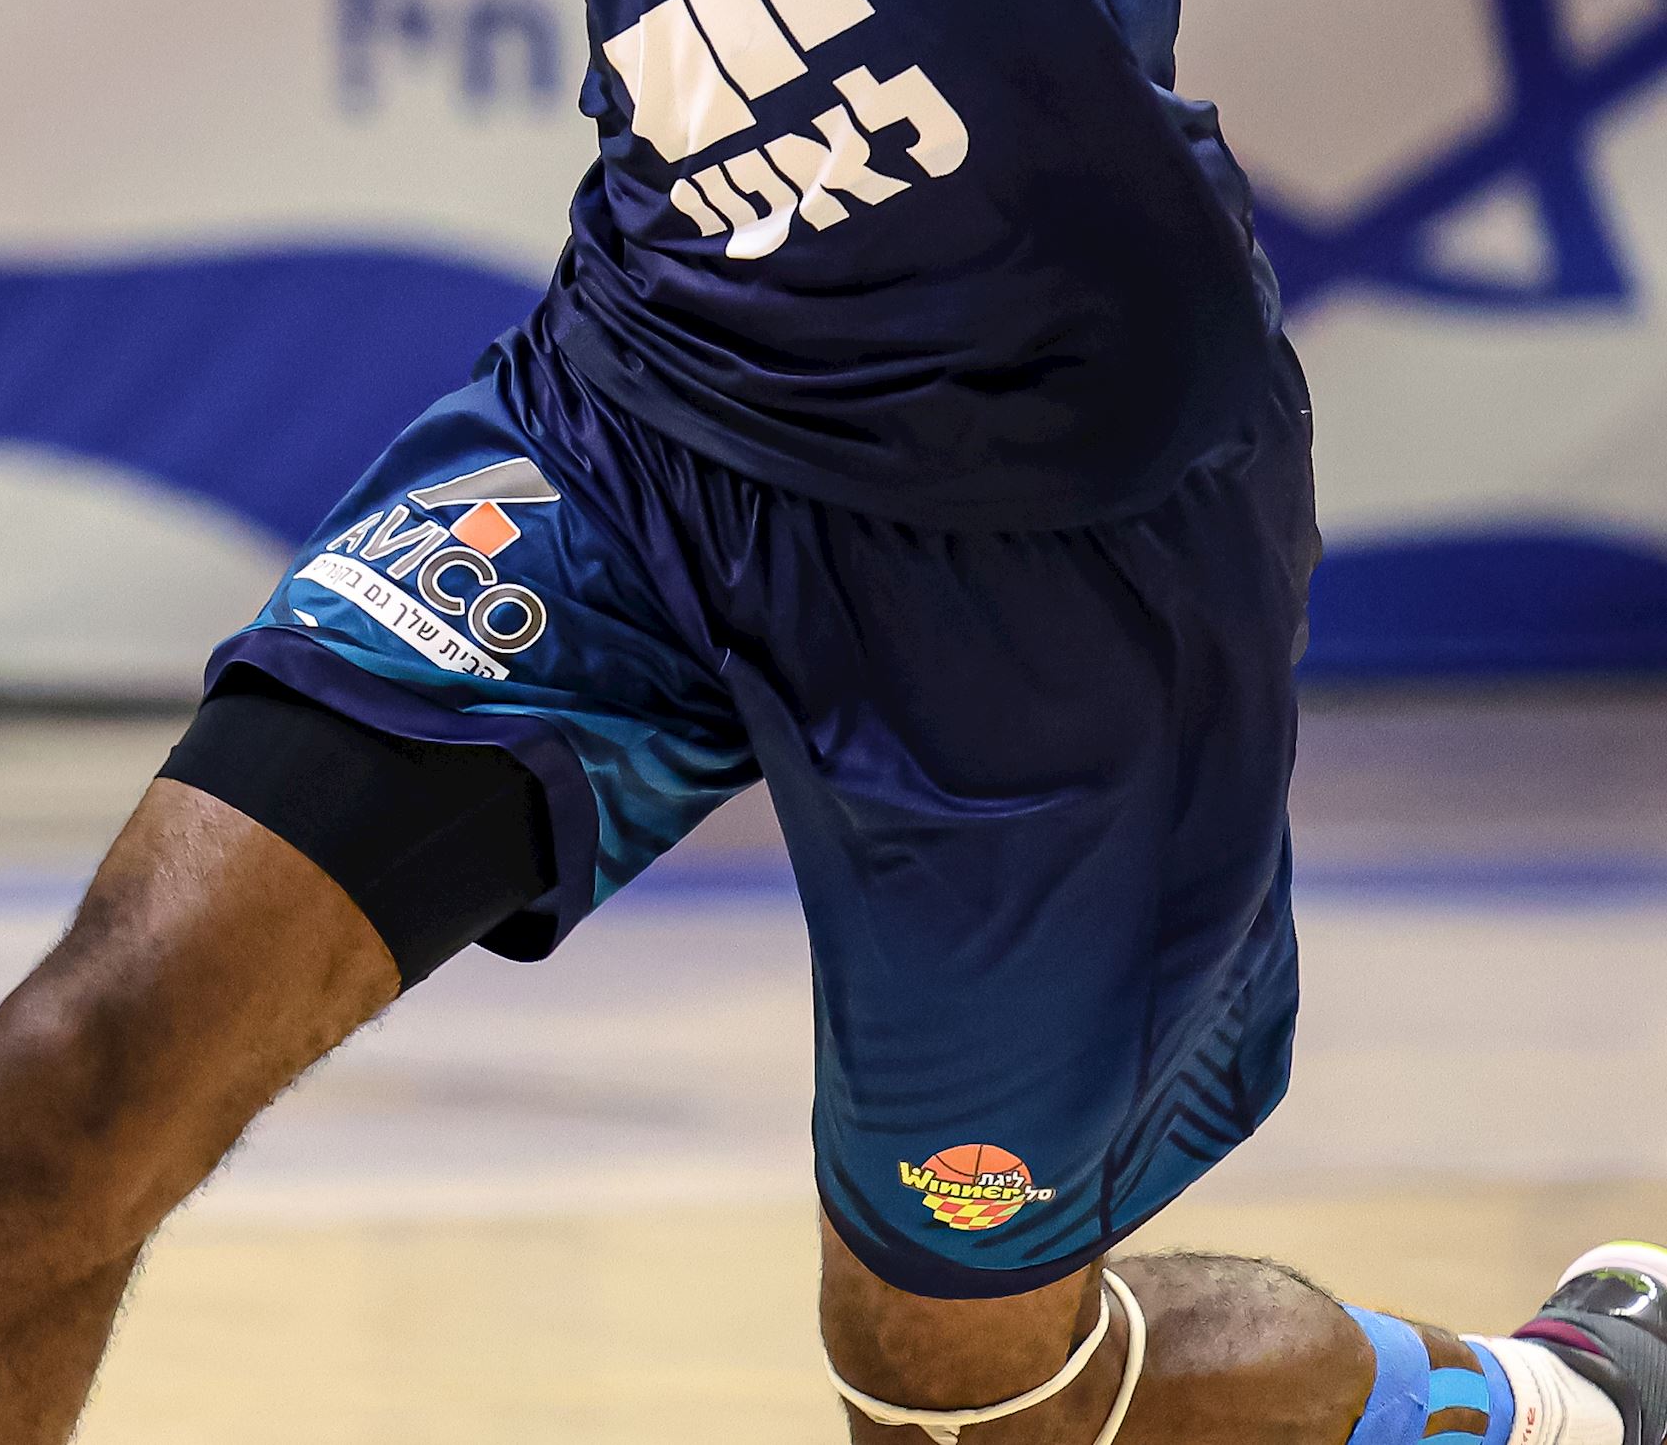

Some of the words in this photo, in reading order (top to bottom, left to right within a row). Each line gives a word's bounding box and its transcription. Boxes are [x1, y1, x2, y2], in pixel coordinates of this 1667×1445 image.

[326, 504, 548, 654] AVICO
[363, 584, 392, 610] גם
[392, 602, 440, 641] שלך
[897, 1160, 1024, 1201] Winner
[1024, 1184, 1057, 1202] סל
[977, 1170, 1026, 1188] ליגת
